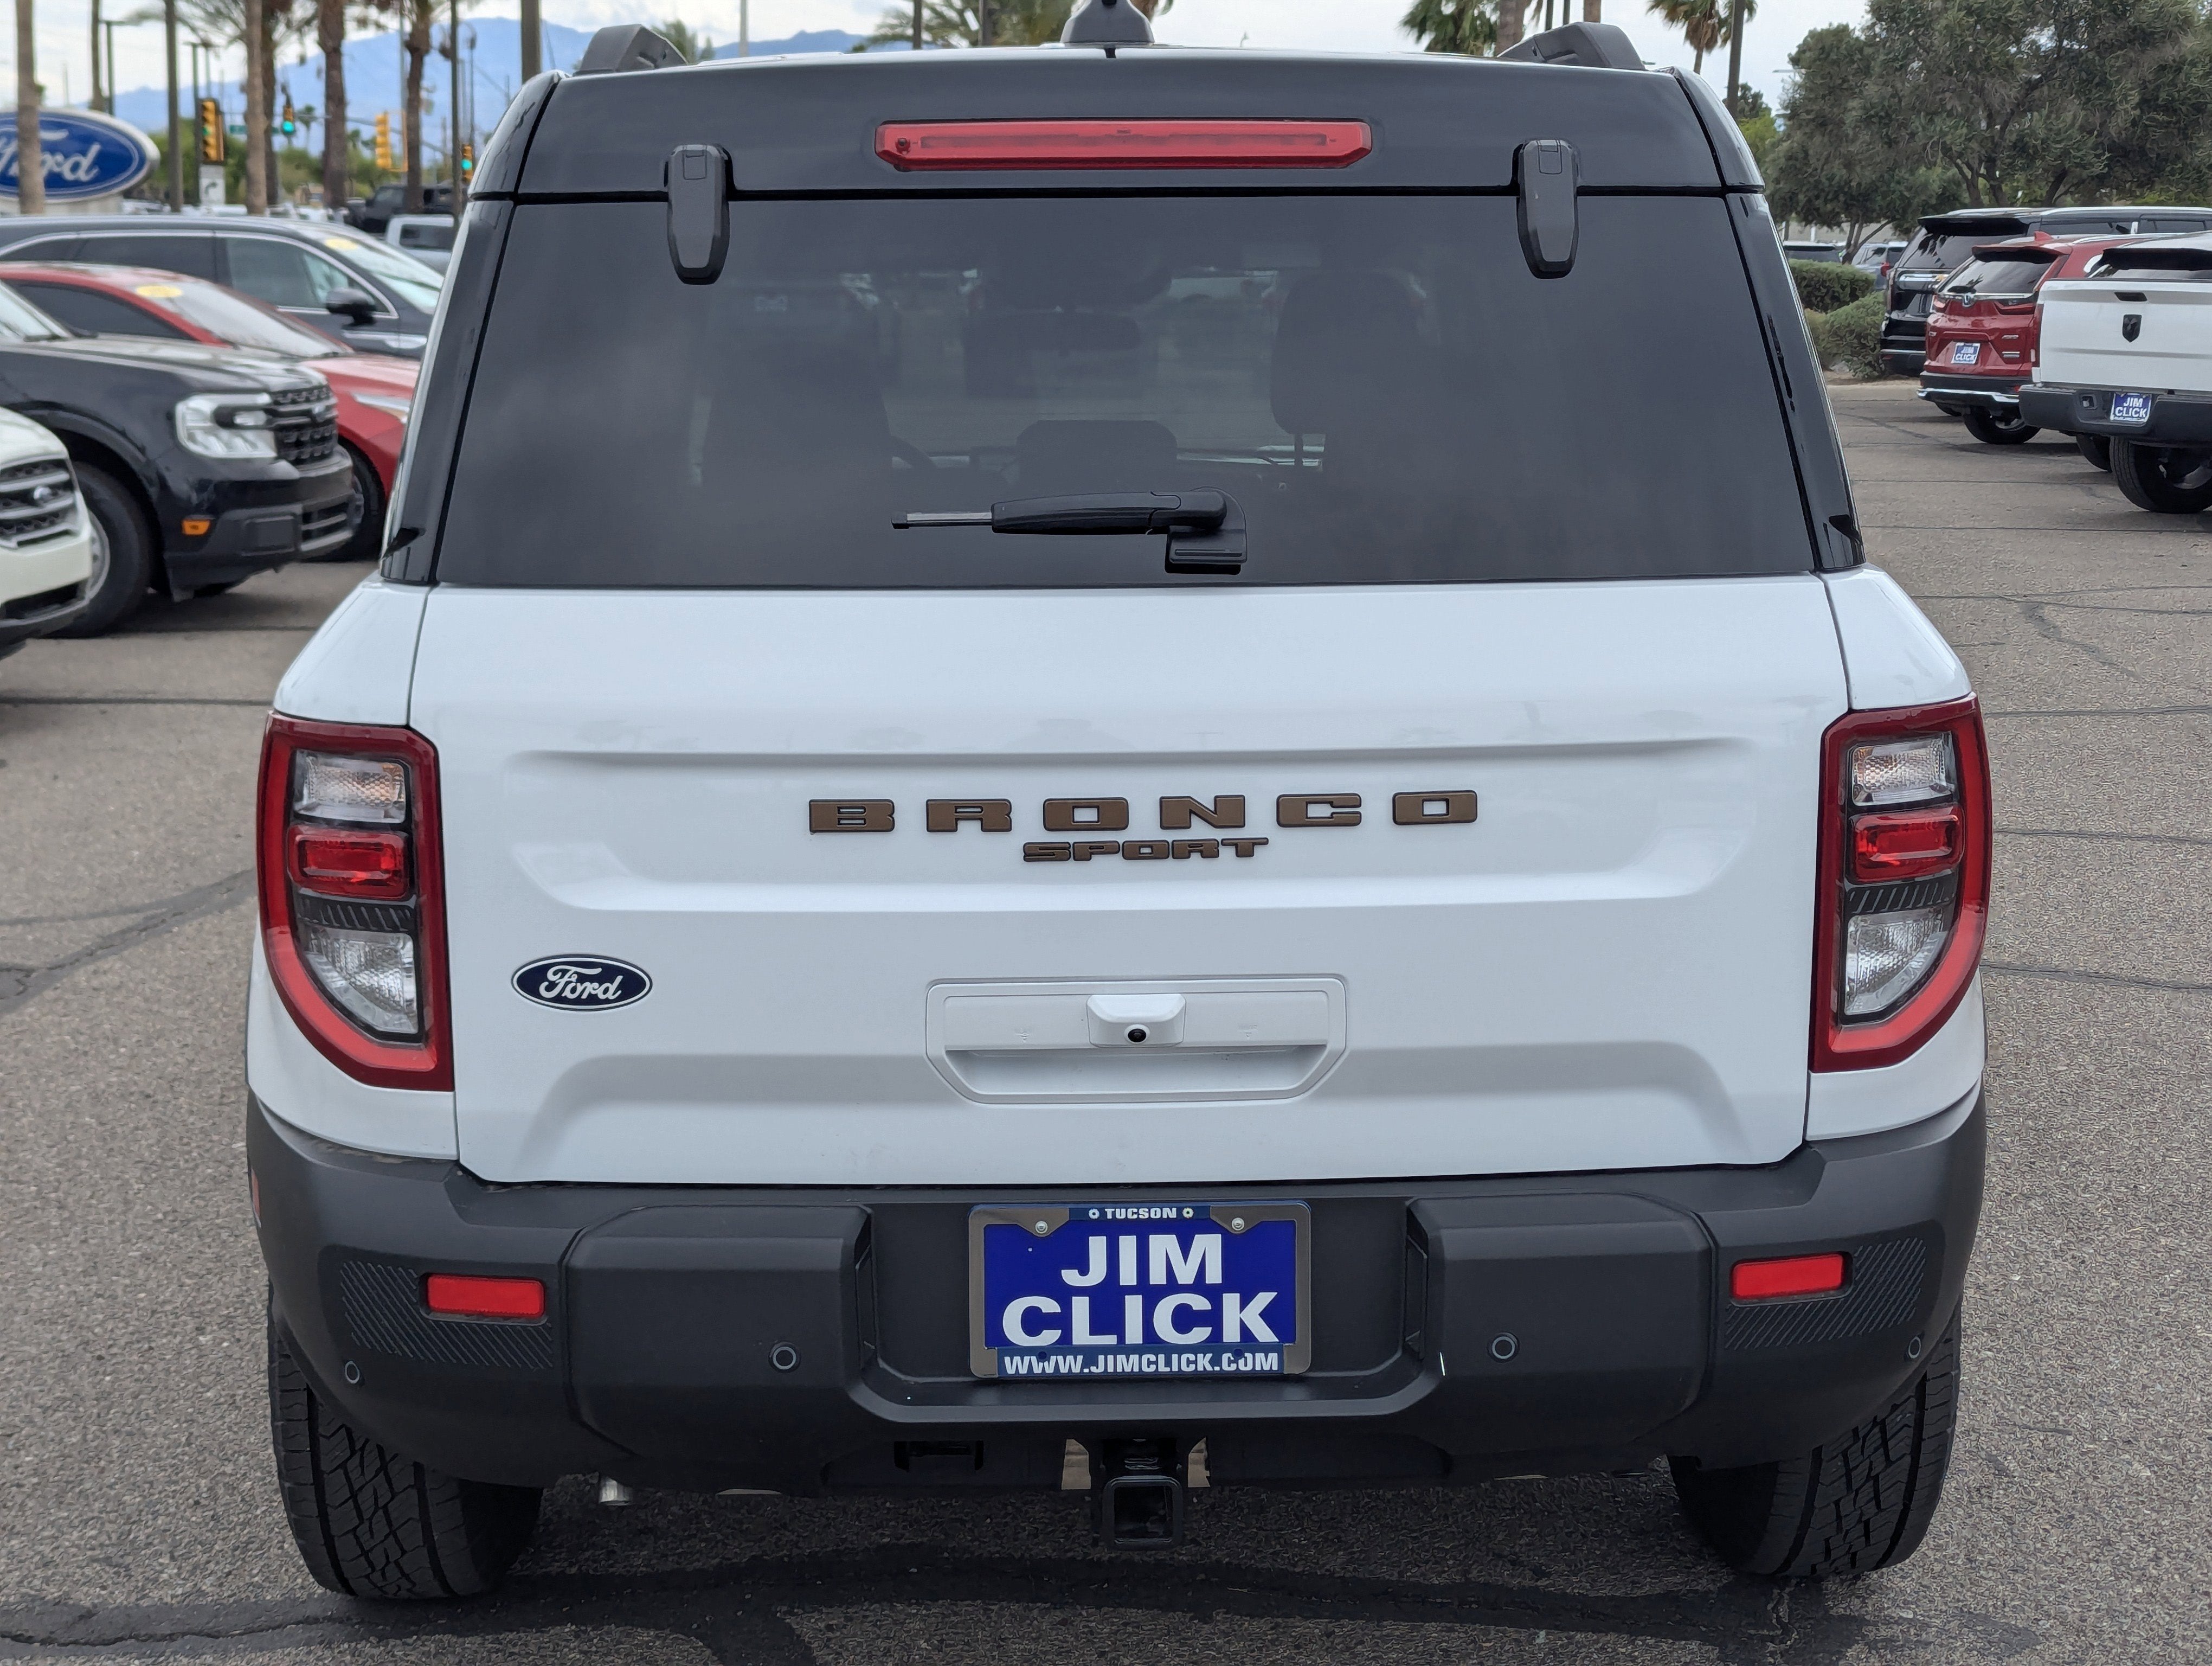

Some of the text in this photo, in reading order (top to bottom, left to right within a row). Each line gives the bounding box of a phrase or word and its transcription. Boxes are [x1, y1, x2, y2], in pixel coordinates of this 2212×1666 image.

[2115, 407, 2147, 418] CLICK
[2123, 397, 2143, 408] JIM
[809, 790, 1478, 835] BRONCO
[1023, 837, 1269, 863] SPORT
[539, 965, 623, 999] Ford
[1104, 1207, 1176, 1219] TUCSON
[1061, 1234, 1222, 1287] JIM
[1002, 1292, 1279, 1347] CLICK
[1004, 1353, 1278, 1374] WWW.JIMCLICK.COM
